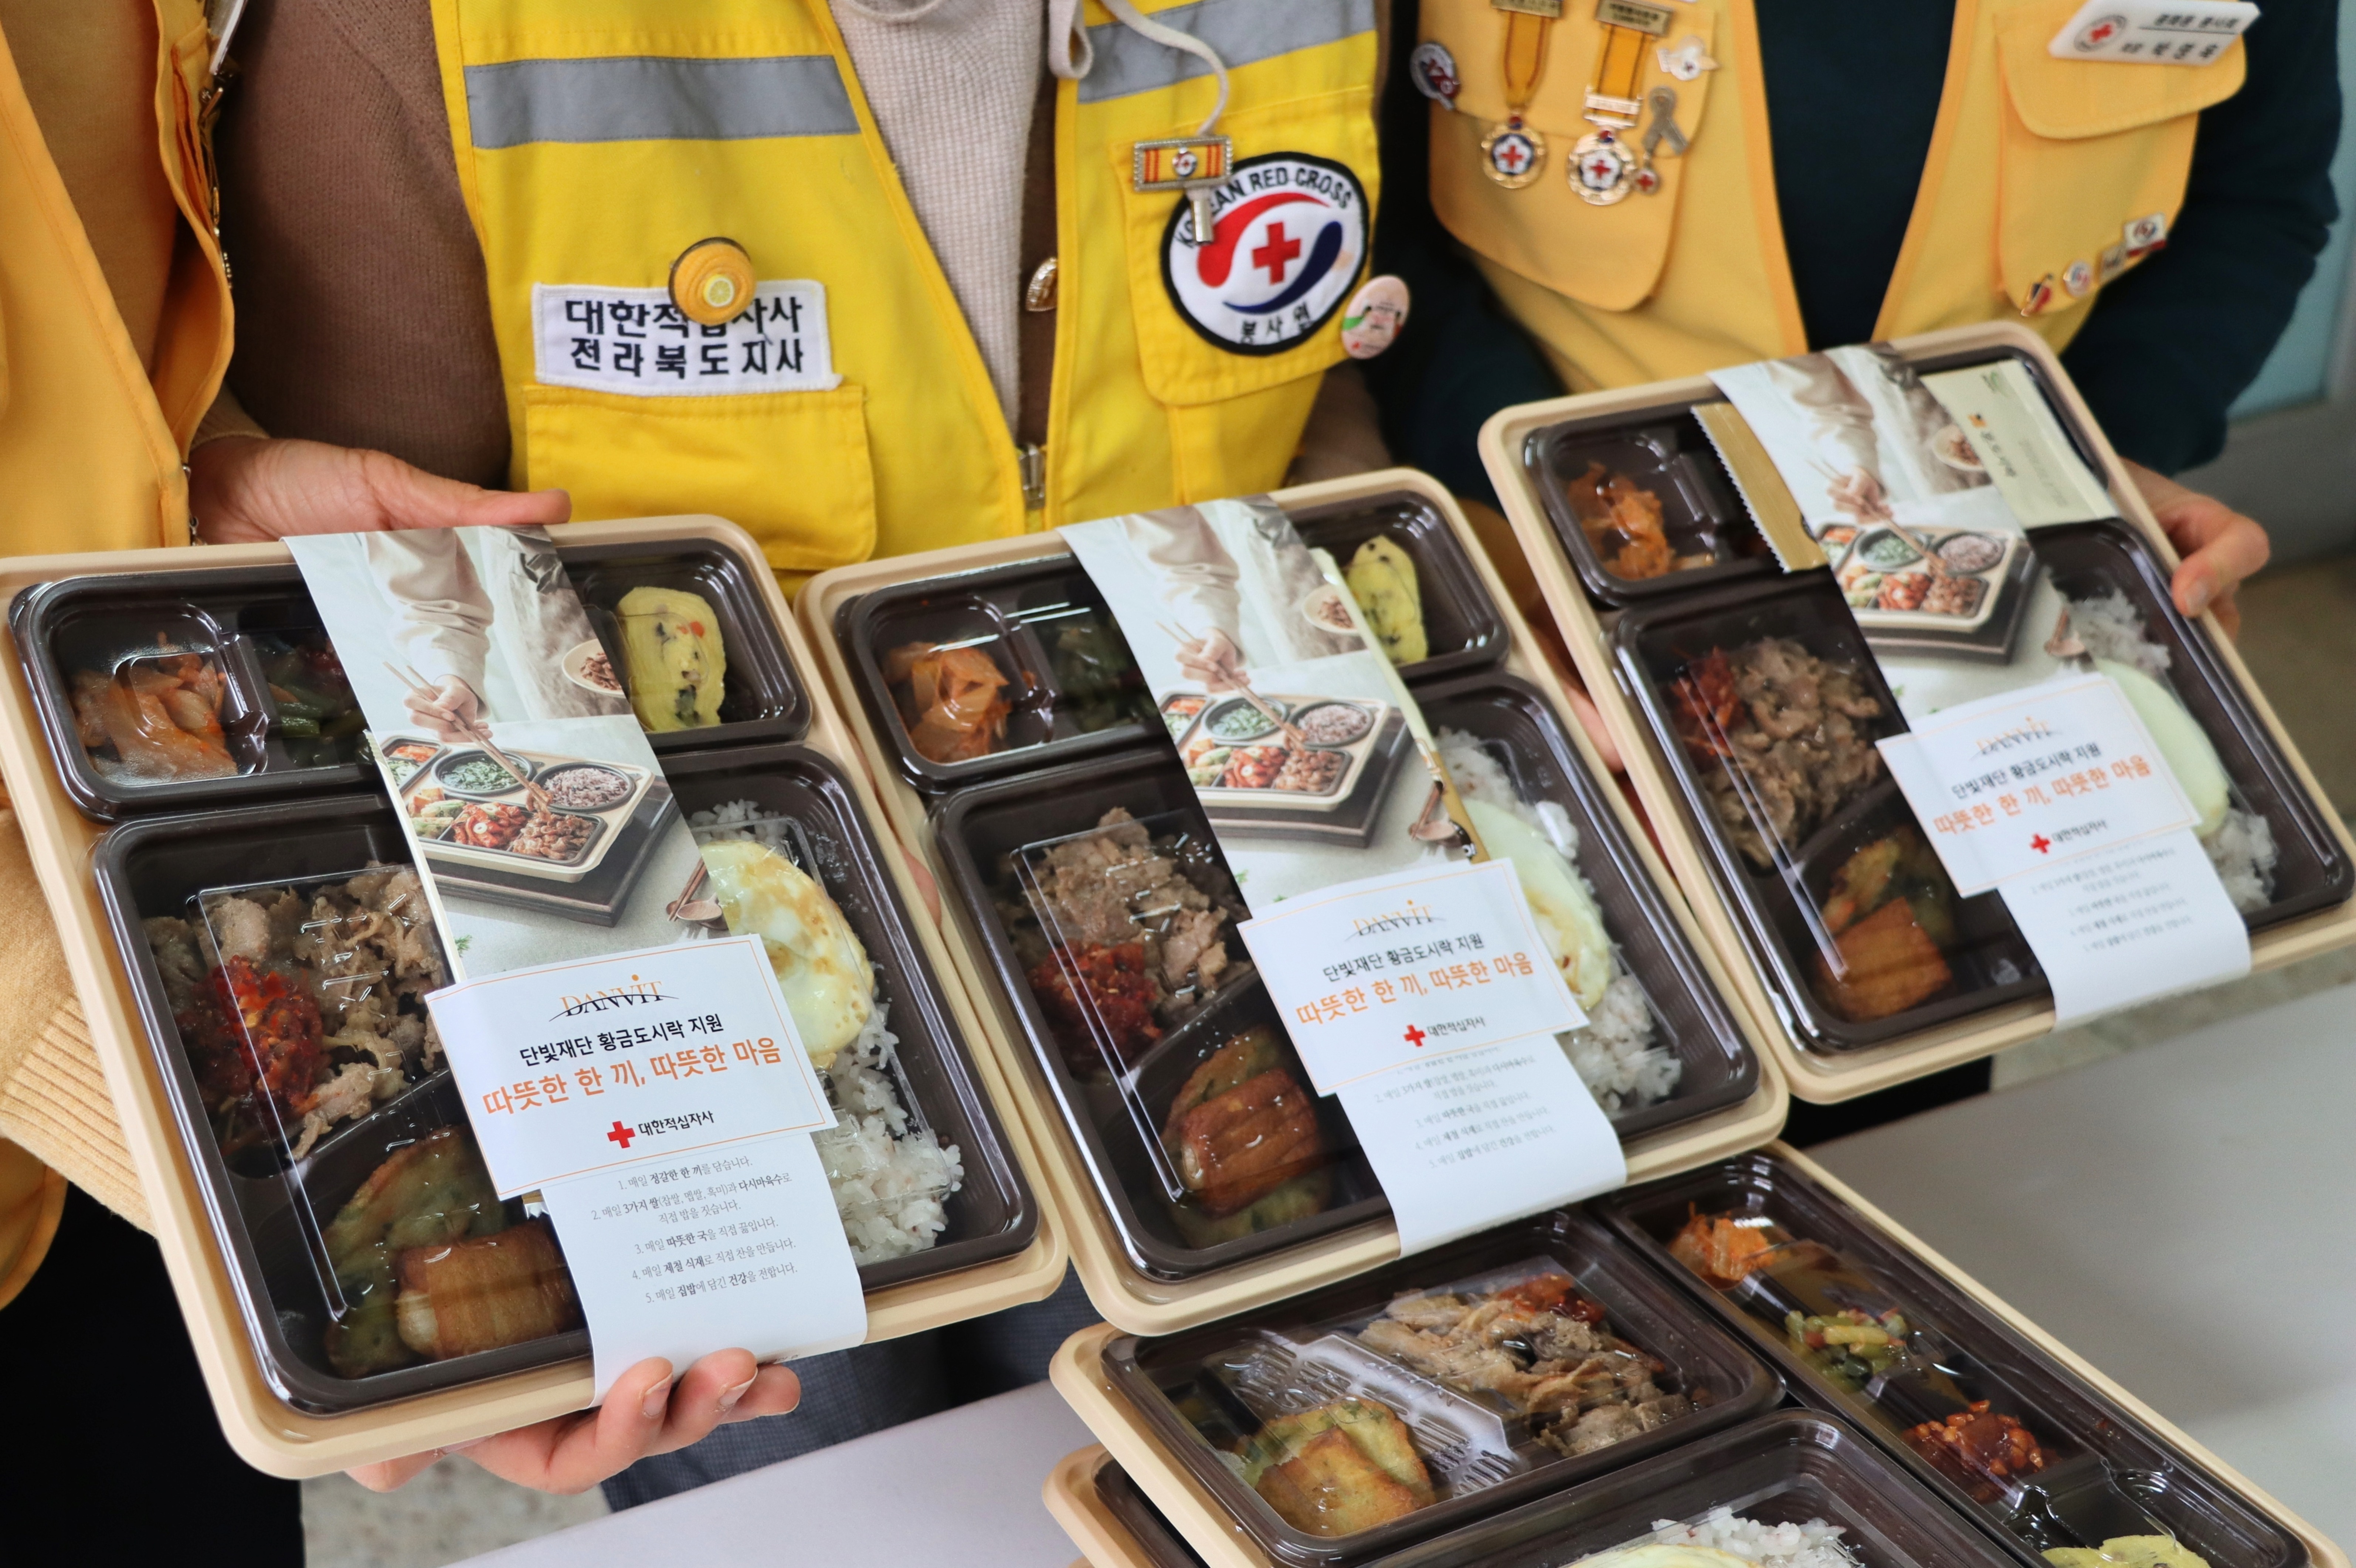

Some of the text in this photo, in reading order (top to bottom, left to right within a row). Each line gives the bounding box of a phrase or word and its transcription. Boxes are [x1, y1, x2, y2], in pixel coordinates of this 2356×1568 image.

[1249, 167, 1289, 191] RED
[1295, 167, 1351, 209] CROSS
[1240, 301, 1312, 344] 봉사원
[571, 338, 803, 380] 전라북도지사
[1951, 741, 2102, 800] 단빛재단 황금도시락 지원
[1934, 804, 1994, 834] 따뜻한
[1998, 794, 2020, 816] 한
[2051, 767, 2109, 797] 따뜻한
[2111, 755, 2151, 778] 마음
[1351, 899, 1434, 937] DANVIT
[1322, 933, 1484, 982] 단빛재단 황금도시락 지원
[559, 973, 663, 1017] DANVIT
[1296, 952, 1533, 1024] 따뜻한 한 끼, 따뜻한 마음
[519, 1013, 724, 1067] 단빛재단 황금도시락 지원
[1426, 1017, 1485, 1036] 대한적십자사
[483, 1037, 781, 1114] 따뜻한 한 끼, 따뜻한 마음
[638, 1110, 714, 1136] 대한적십자사
[618, 1155, 753, 1189] 1. 매일 정갈한 한 끼를 담습니다.
[591, 1210, 601, 1220] 2.
[601, 1204, 622, 1217] 매일
[622, 1199, 648, 1214] 3가지
[683, 1188, 706, 1202] 멥쌀,
[738, 1172, 792, 1191] 다시마육수로
[658, 1199, 741, 1224] 직접 밥을 짓습니다.
[634, 1216, 778, 1254] 3. 매일 따뜻한 국을 직접 끓입니다.
[632, 1237, 796, 1279] 4. 매일 제철 식재로 직접 찬을 만듭니다.
[645, 1262, 797, 1303] 5. 매일 집밥에 담긴 건강을 전합니다.
